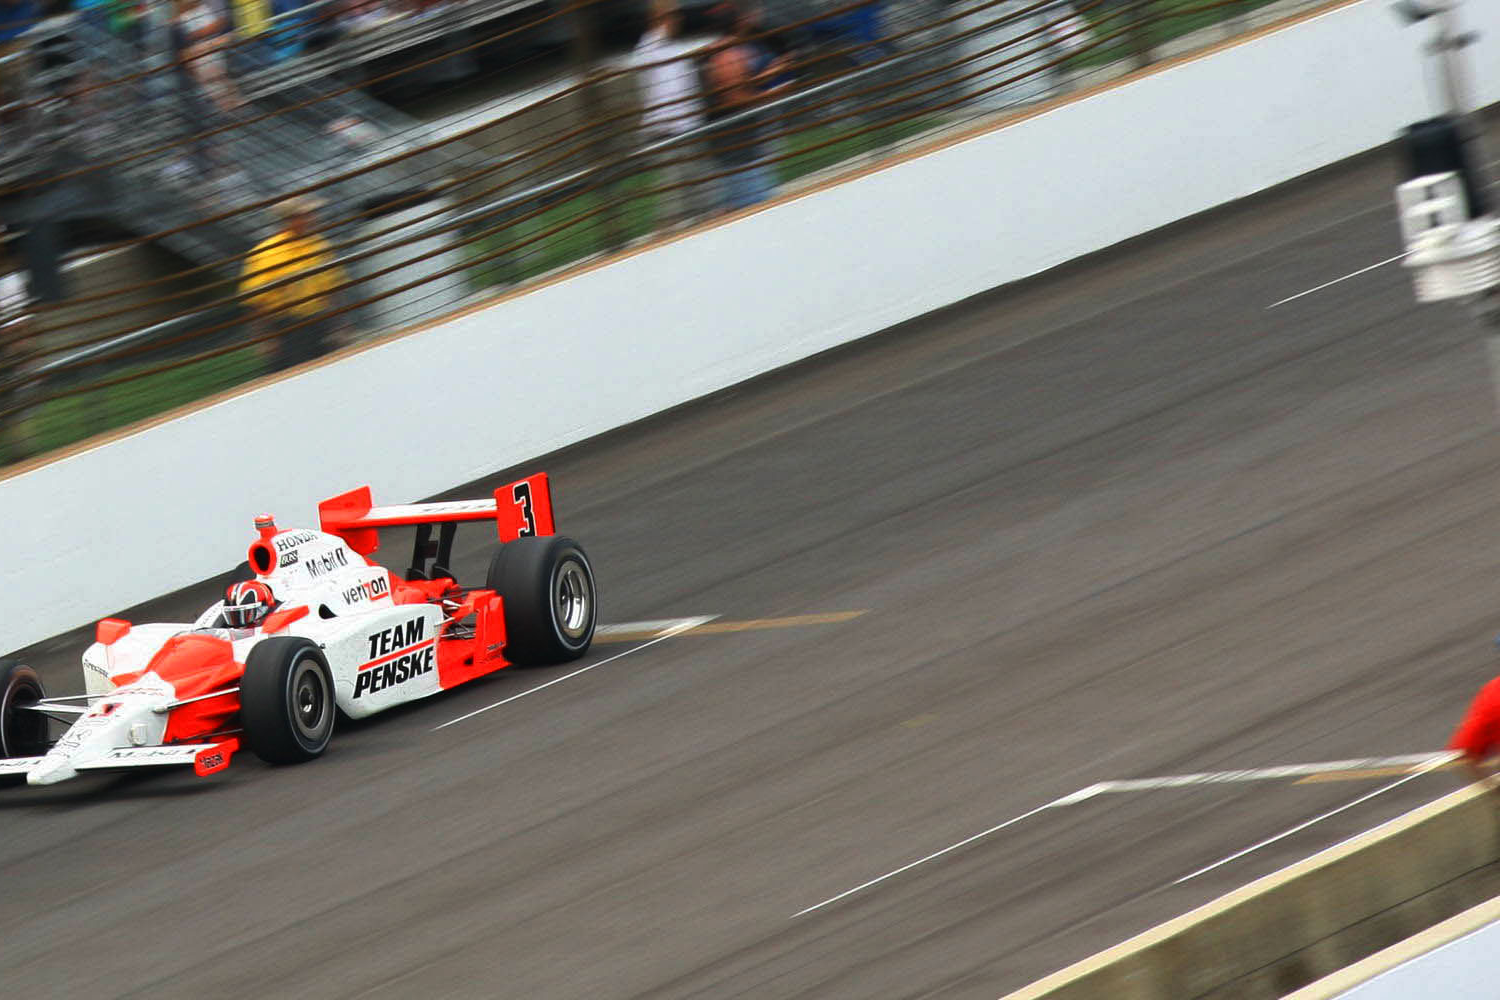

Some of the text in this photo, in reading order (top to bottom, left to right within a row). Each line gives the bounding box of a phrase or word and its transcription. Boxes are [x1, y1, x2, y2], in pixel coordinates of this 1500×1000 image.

[512, 480, 537, 538] 3
[276, 531, 318, 551] HONDA
[306, 552, 338, 579] Mobil
[342, 576, 387, 605] verizon
[368, 616, 424, 660] TEAM
[353, 645, 434, 699] PENSKE
